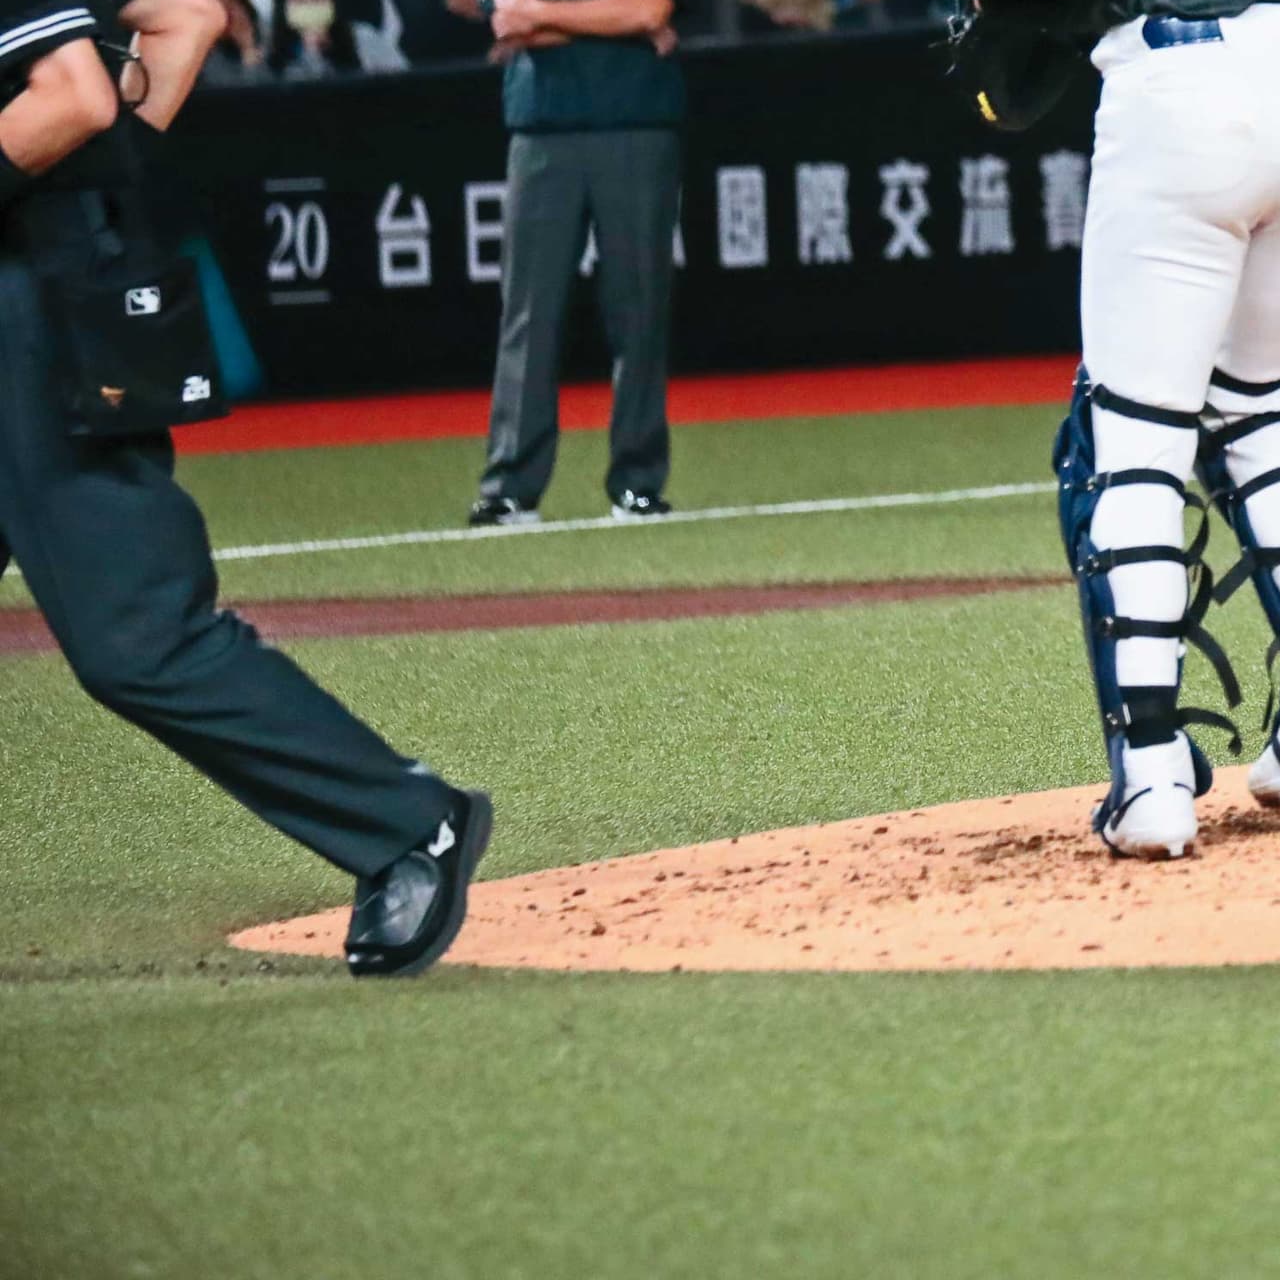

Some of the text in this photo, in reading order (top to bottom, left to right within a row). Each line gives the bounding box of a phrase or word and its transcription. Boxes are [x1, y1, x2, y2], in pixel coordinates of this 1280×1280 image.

[263, 150, 1090, 288] 20 台日國際交流賽
